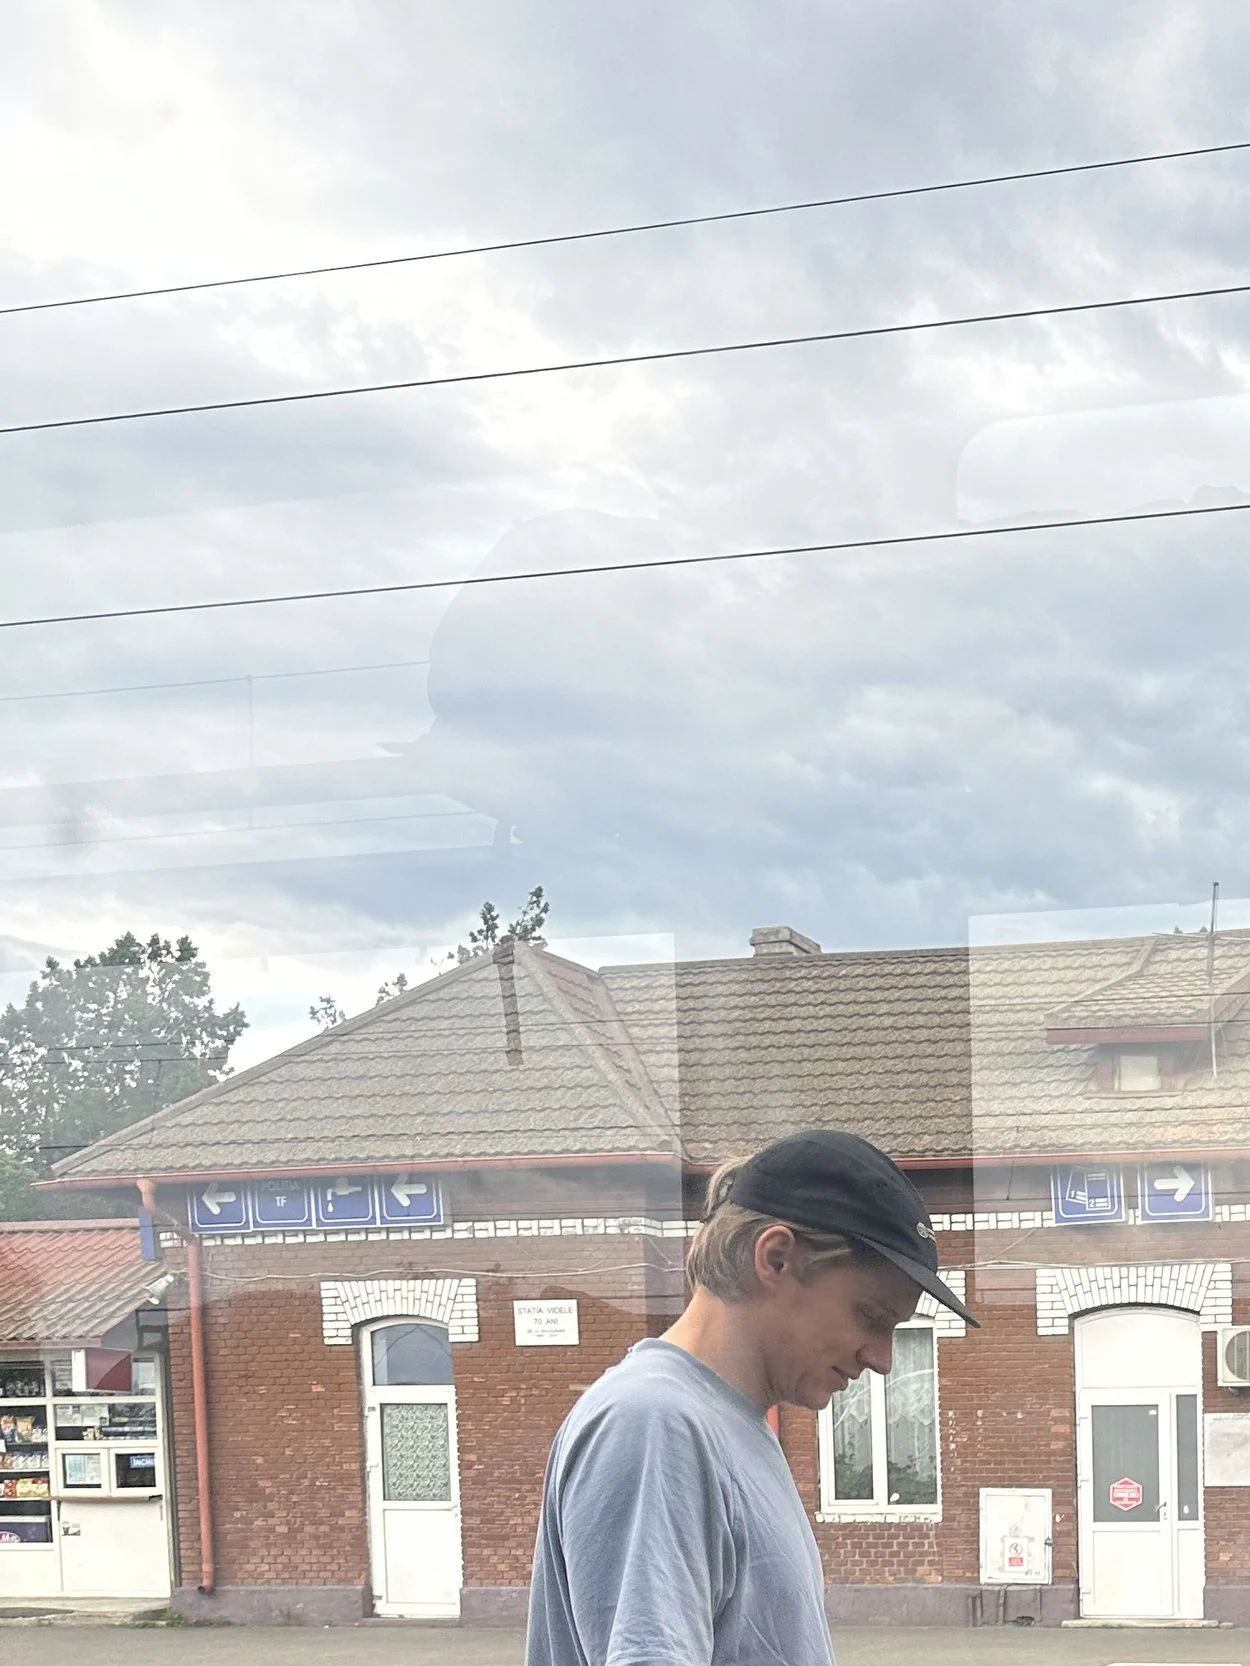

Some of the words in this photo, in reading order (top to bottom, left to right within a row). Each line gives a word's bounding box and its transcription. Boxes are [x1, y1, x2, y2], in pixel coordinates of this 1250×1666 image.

[1070, 1190, 1075, 1198] 1
[275, 1196, 287, 1207] TF
[1089, 1199, 1095, 1207] 2
[546, 1306, 573, 1314] VIDELE
